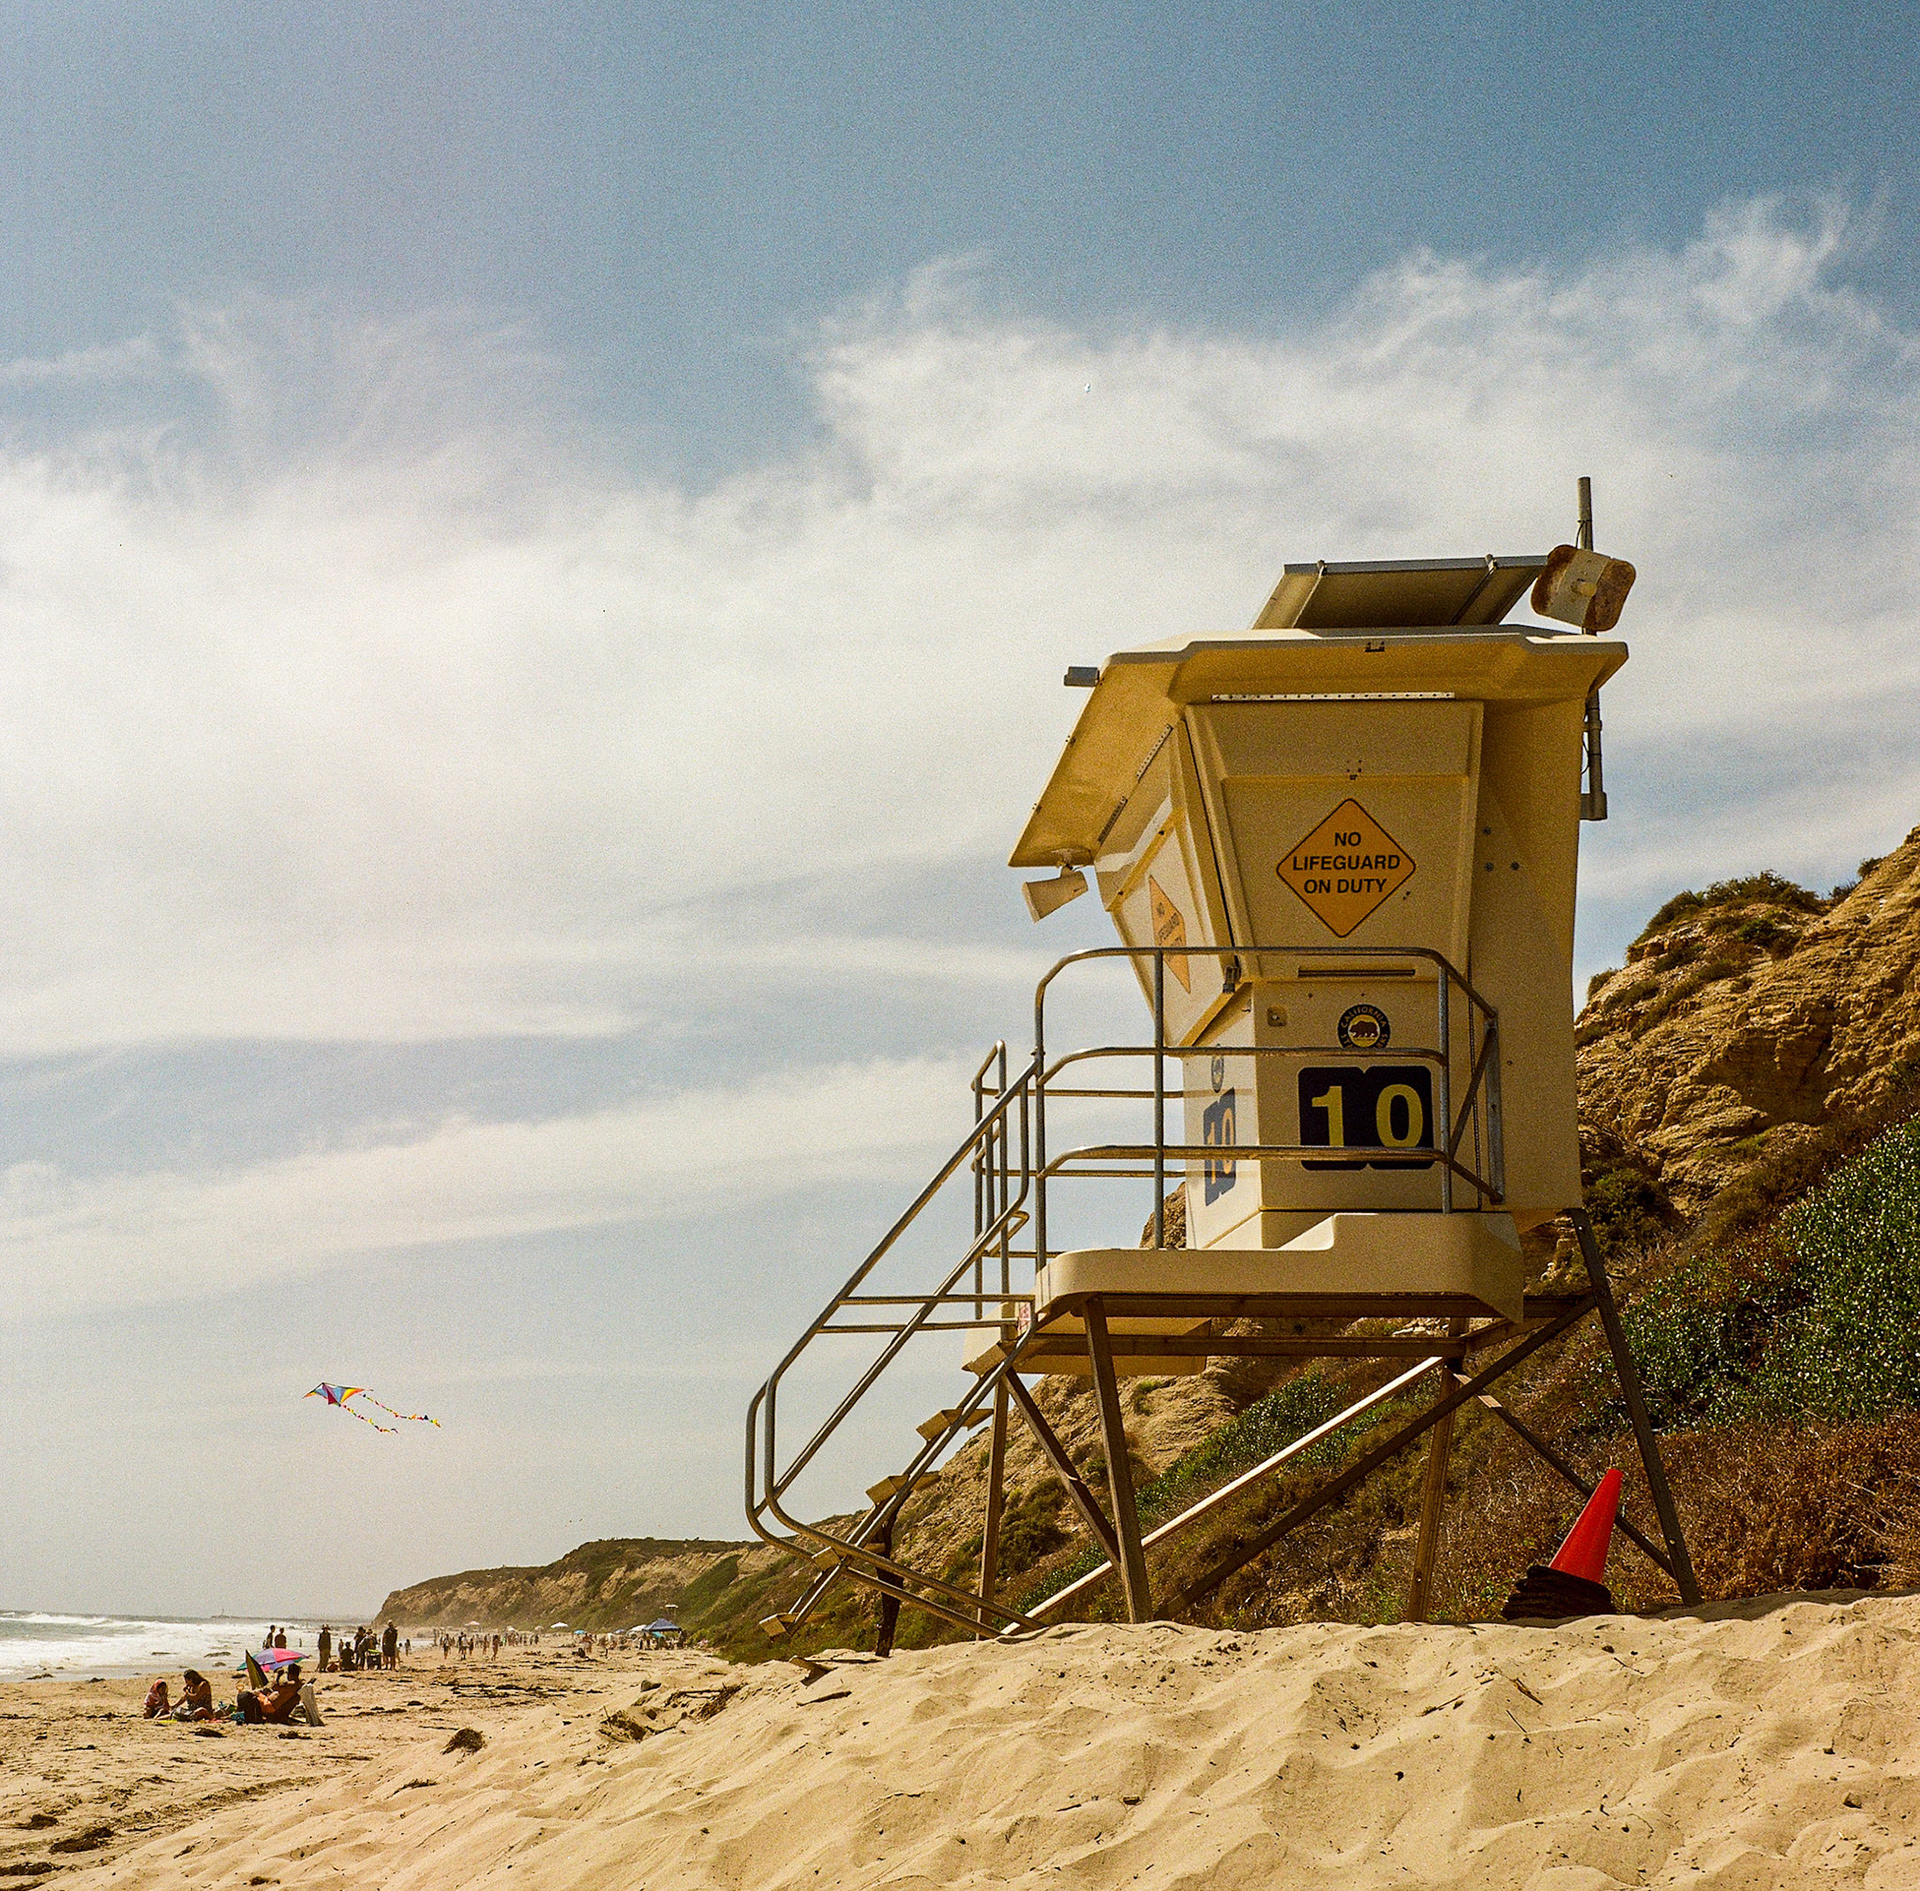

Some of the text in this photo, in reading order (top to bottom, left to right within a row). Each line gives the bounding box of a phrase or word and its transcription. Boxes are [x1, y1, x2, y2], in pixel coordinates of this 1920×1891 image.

[1334, 832, 1362, 847] NO
[1292, 855, 1401, 871] LIFEGUARD
[1303, 878, 1387, 894] ON DUTY
[1340, 1006, 1387, 1028] CALIFORNIA
[1311, 1083, 1423, 1148] 10
[1207, 1107, 1234, 1185] 10
